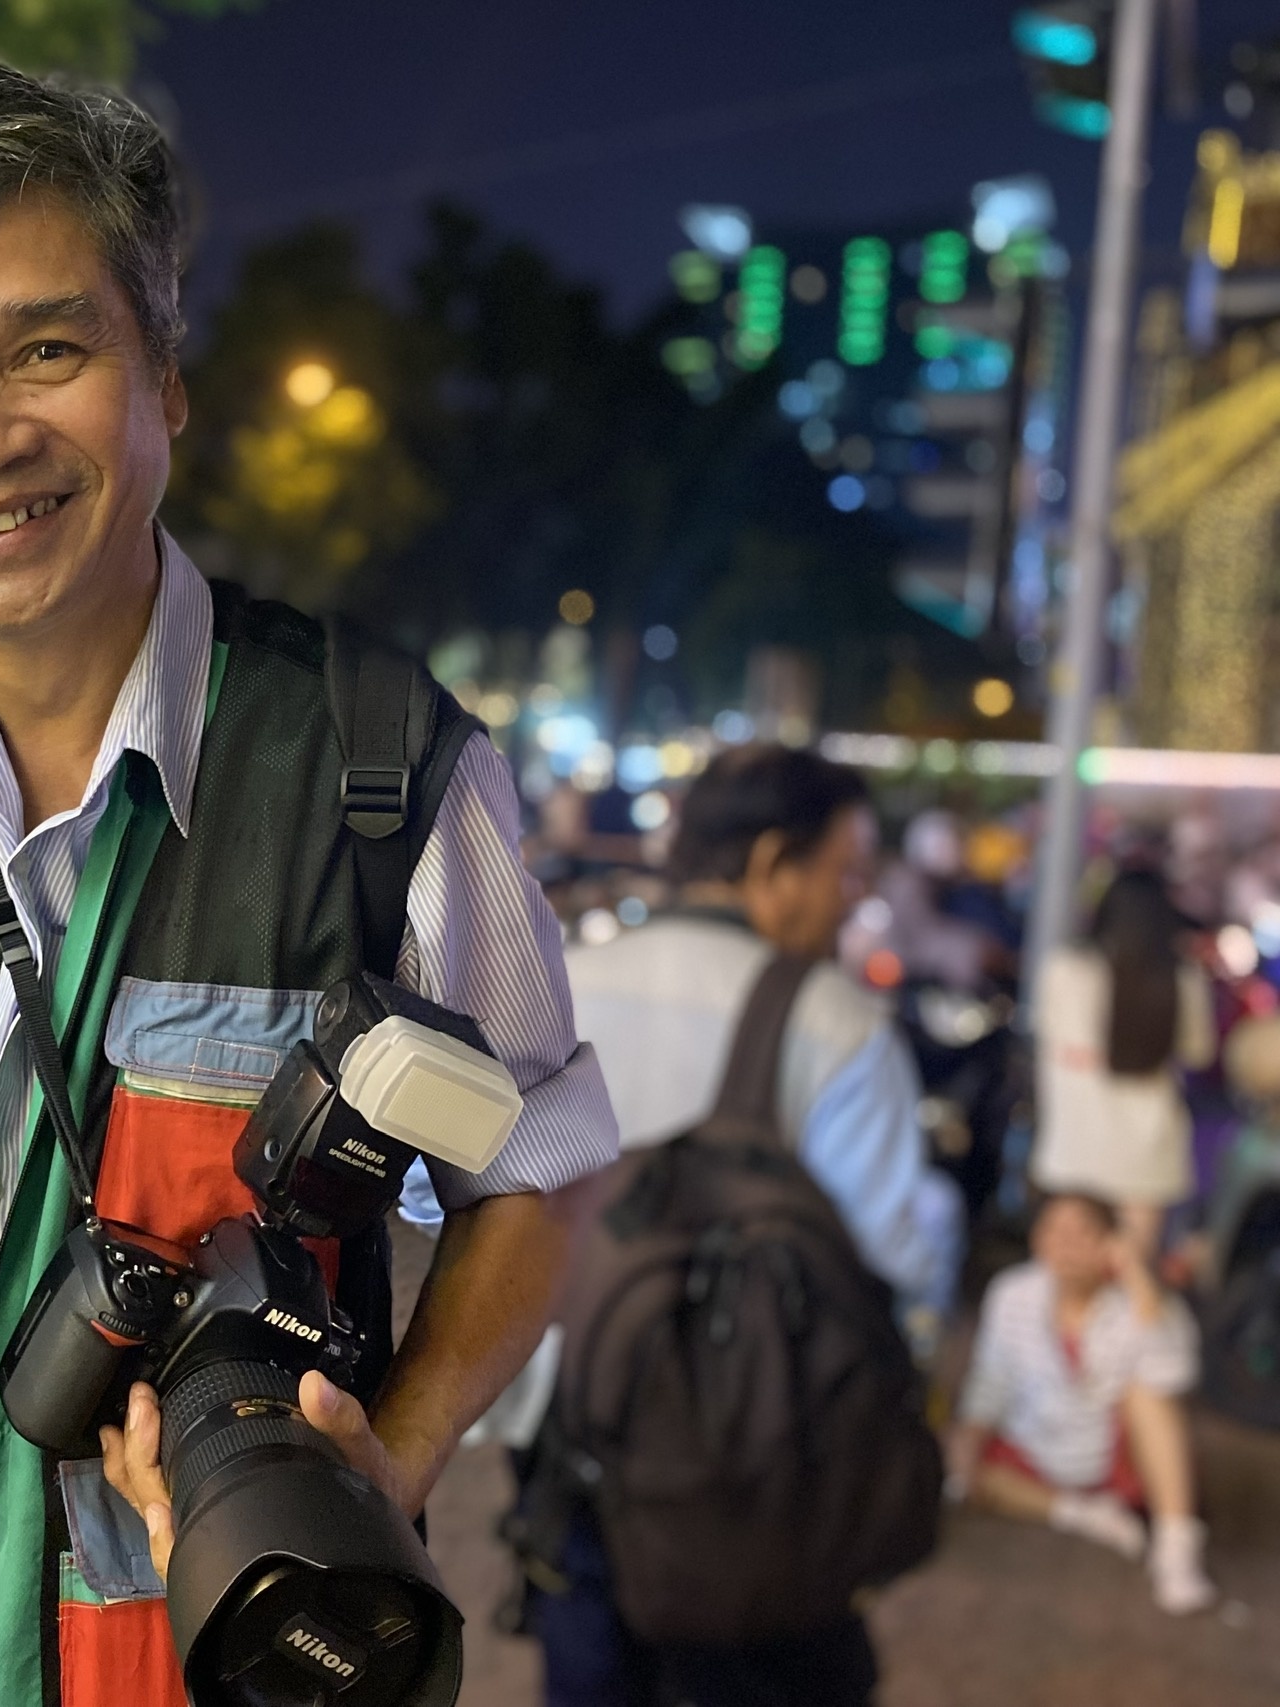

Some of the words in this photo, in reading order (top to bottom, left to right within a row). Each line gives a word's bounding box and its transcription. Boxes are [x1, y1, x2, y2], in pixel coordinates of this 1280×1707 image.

[328, 1148, 367, 1168] SPEEDLIGHT
[342, 1138, 386, 1164] Nikon
[264, 1308, 322, 1342] Nikon
[286, 1629, 355, 1677] Nikon
